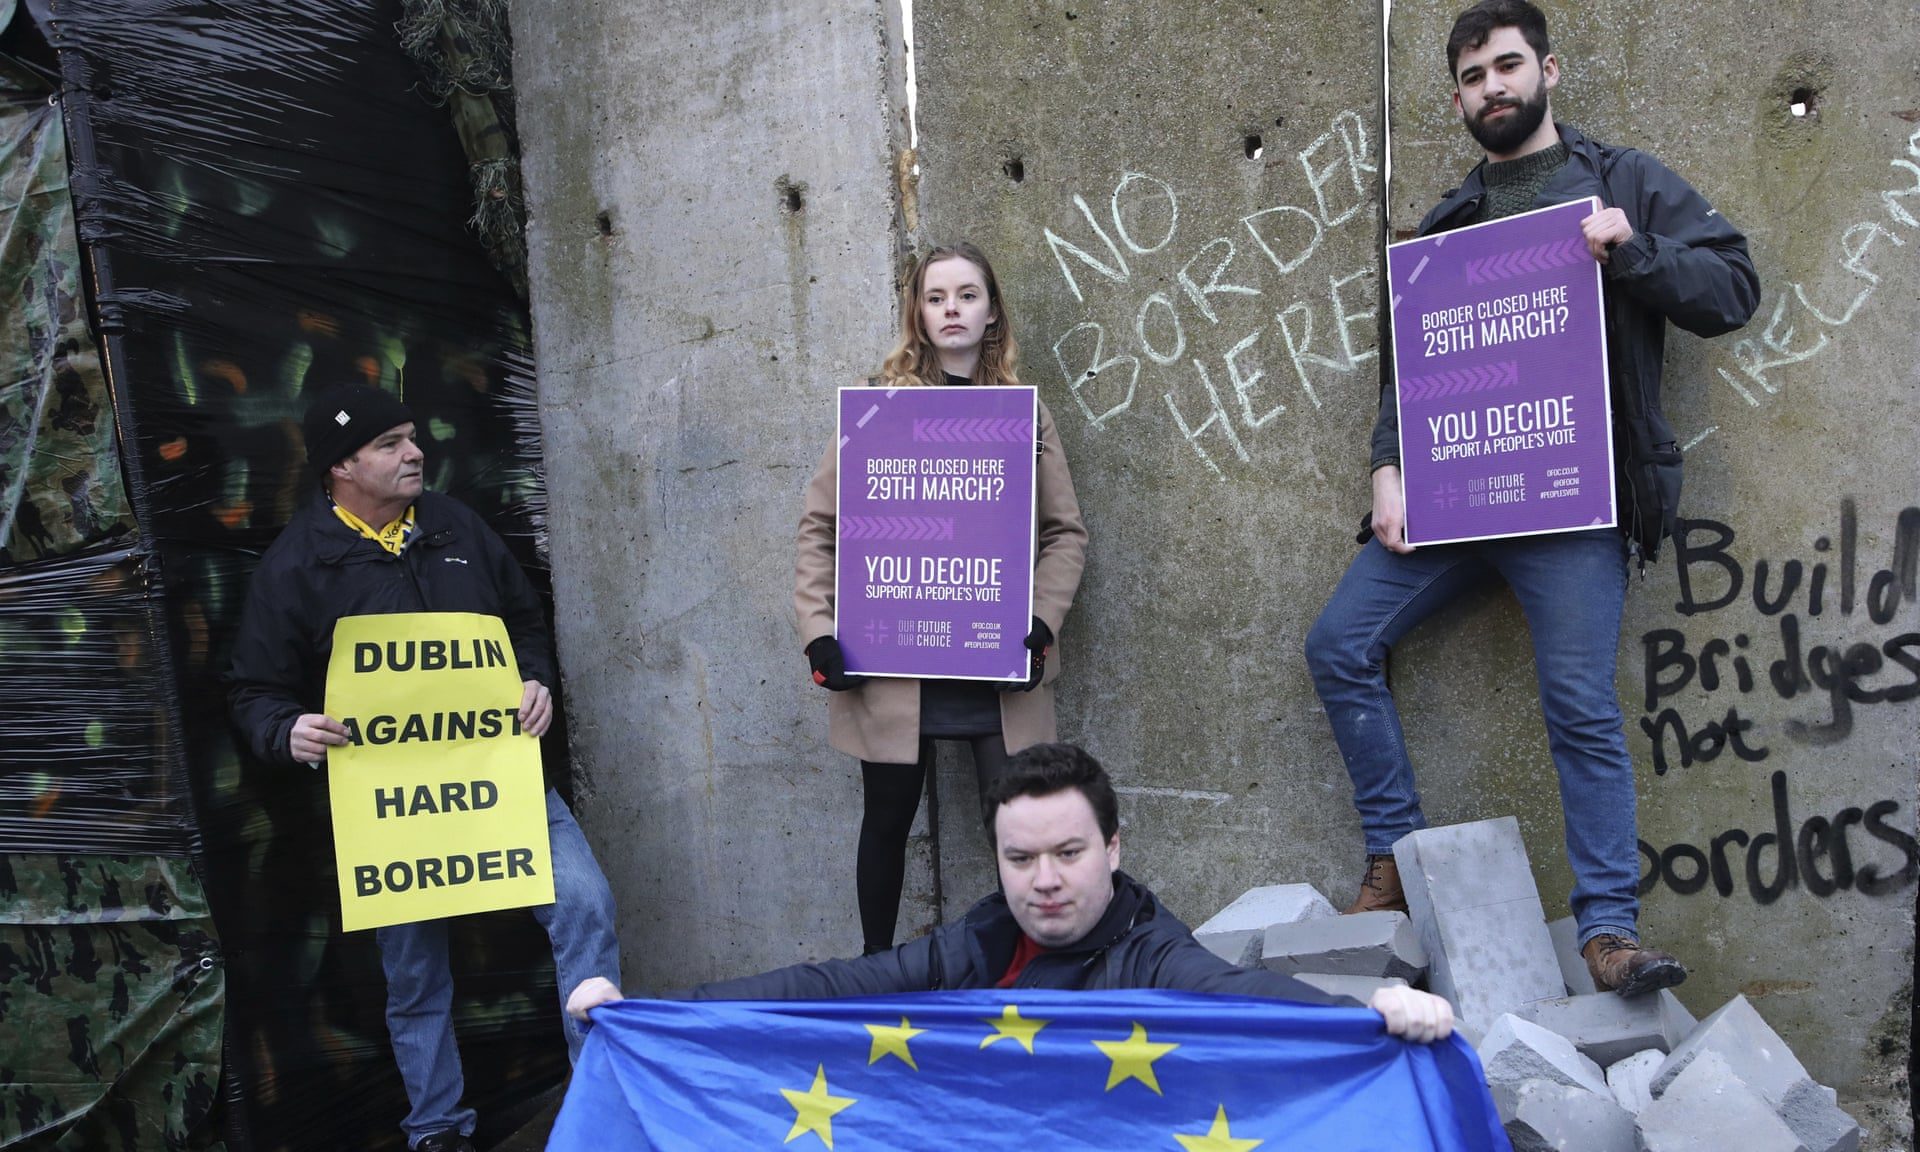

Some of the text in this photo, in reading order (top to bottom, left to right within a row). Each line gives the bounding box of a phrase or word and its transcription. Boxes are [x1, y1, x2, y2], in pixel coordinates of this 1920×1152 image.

[1044, 171, 1178, 302] NO
[1052, 109, 1377, 431] BORDER
[1421, 285, 1569, 330] BORDER CLOSED HERE
[1423, 306, 1569, 357] 29TH MARCH?
[1163, 266, 1379, 481] HERE
[1428, 395, 1576, 444] YOU DECIDE
[1431, 428, 1576, 462] SUPPORT A PEOPLE'S VOTE
[867, 458, 1005, 476] BORDER CLOSED HERE
[1468, 473, 1526, 493] OUR FUTURE
[866, 476, 1005, 501] 29TH MARCH?
[1468, 488, 1527, 508] OUR CHOICE
[865, 556, 1002, 586] YOU DECIDE
[1671, 495, 1920, 625] Build
[865, 584, 1001, 602] SUPPORT A PEOPLE'S VOTE
[897, 633, 952, 648] OUR CHOICE
[898, 619, 952, 634] OUR FUTURE
[354, 639, 507, 673] DUBLIN
[1642, 613, 1920, 745] Bridges
[342, 707, 524, 746] AGAINST
[375, 780, 499, 819] HARD
[354, 848, 536, 897] BORDER
